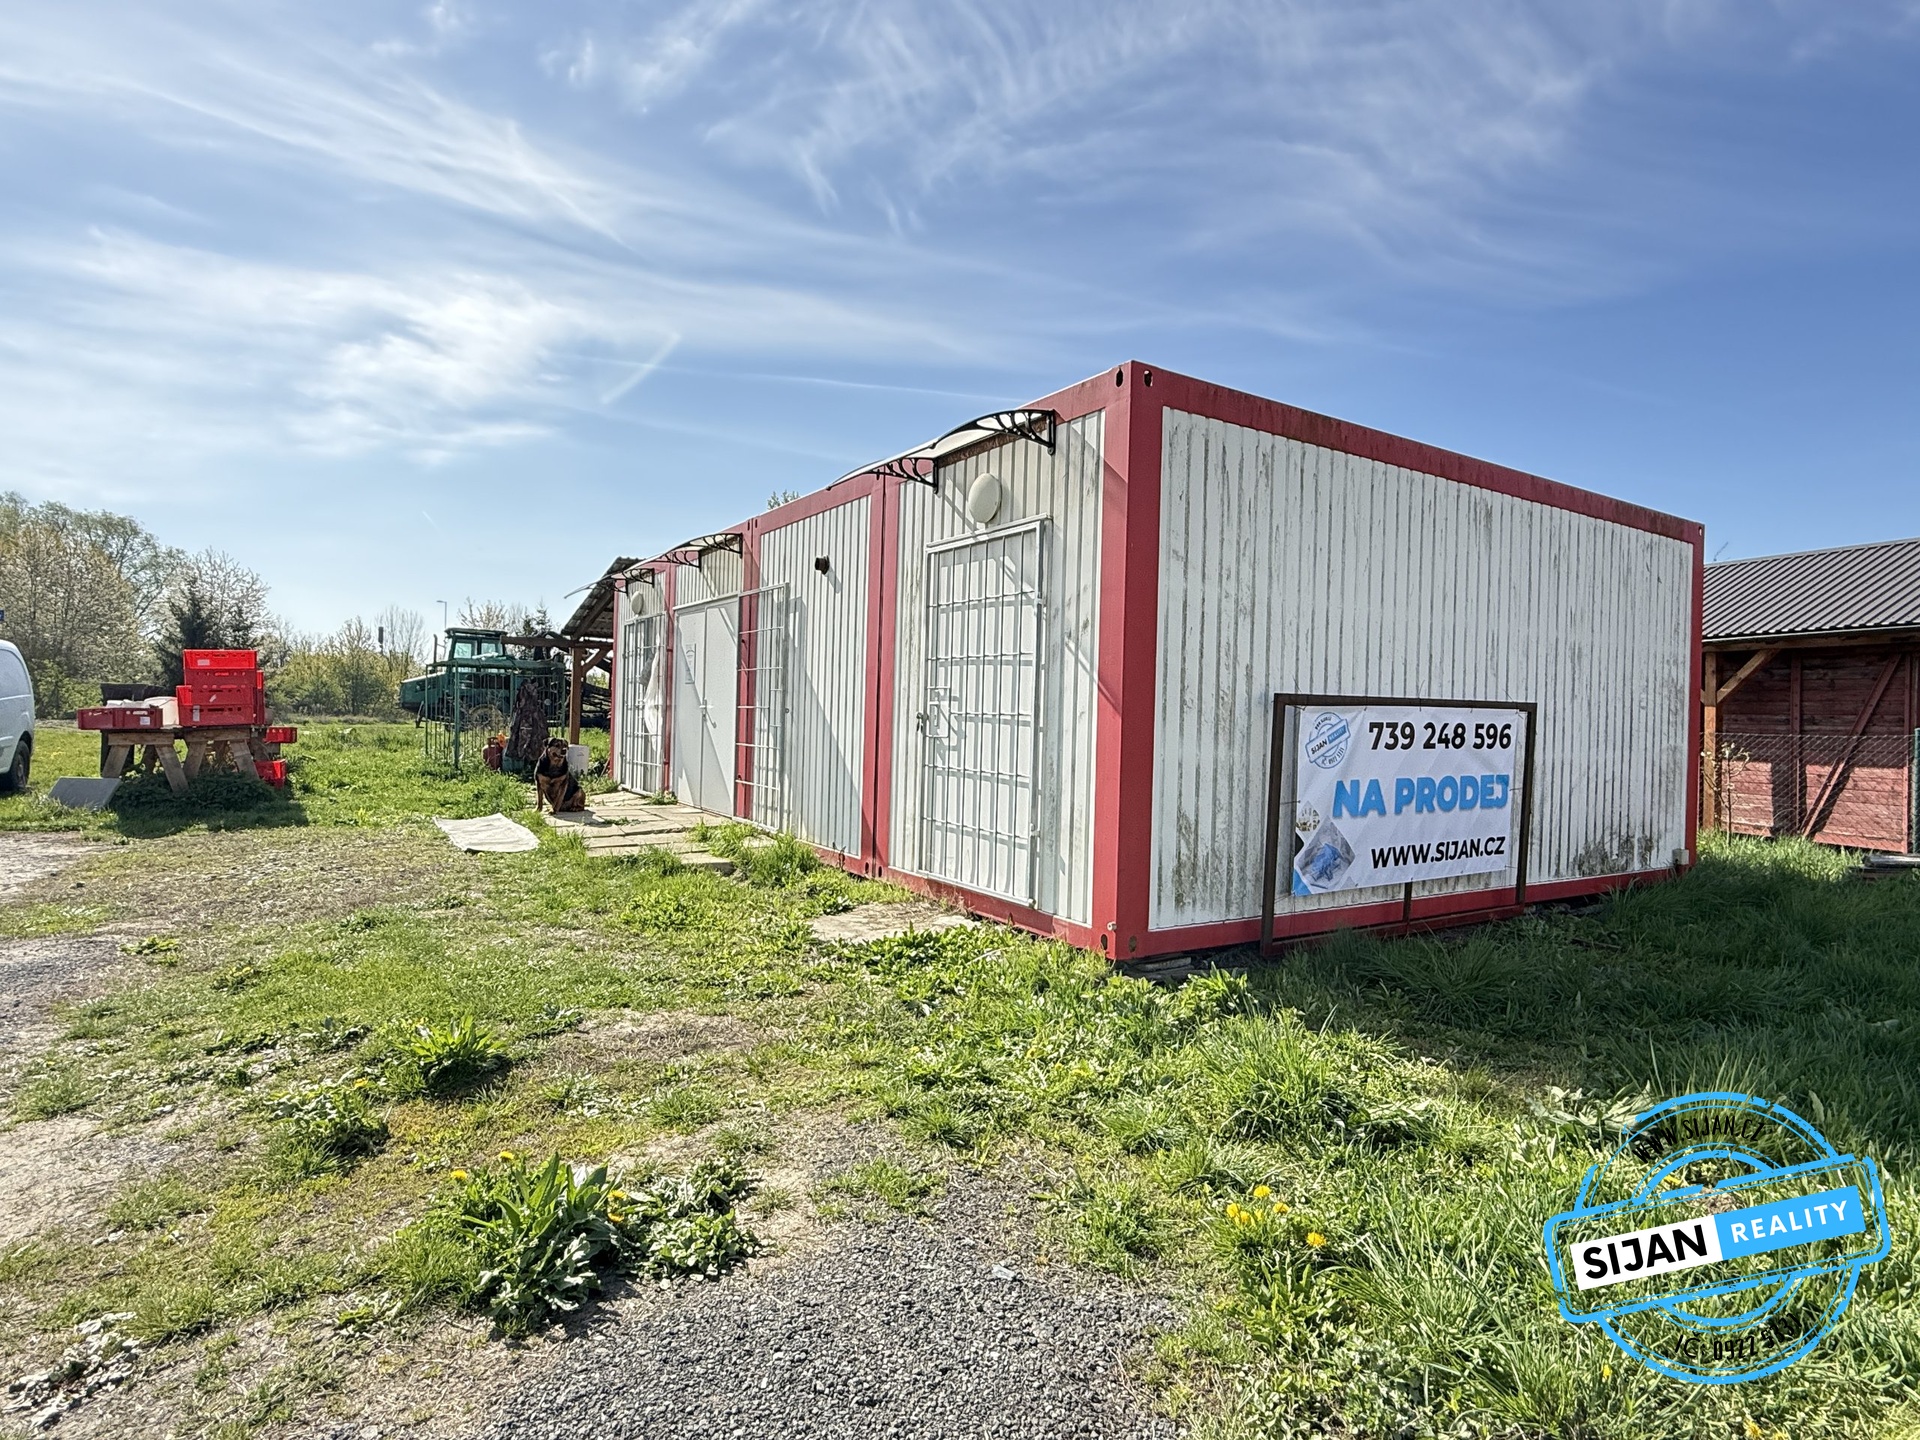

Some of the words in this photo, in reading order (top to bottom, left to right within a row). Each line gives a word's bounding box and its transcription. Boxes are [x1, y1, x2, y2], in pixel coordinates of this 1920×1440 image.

[1310, 738, 1328, 755] SIJAN
[1369, 722, 1415, 750] 739
[1423, 722, 1466, 749] 248
[1472, 723, 1512, 749] 596
[1332, 778, 1386, 819] NA
[1394, 774, 1510, 815] PRODEJ
[1371, 836, 1506, 869] WWW.SIJAN.CZ
